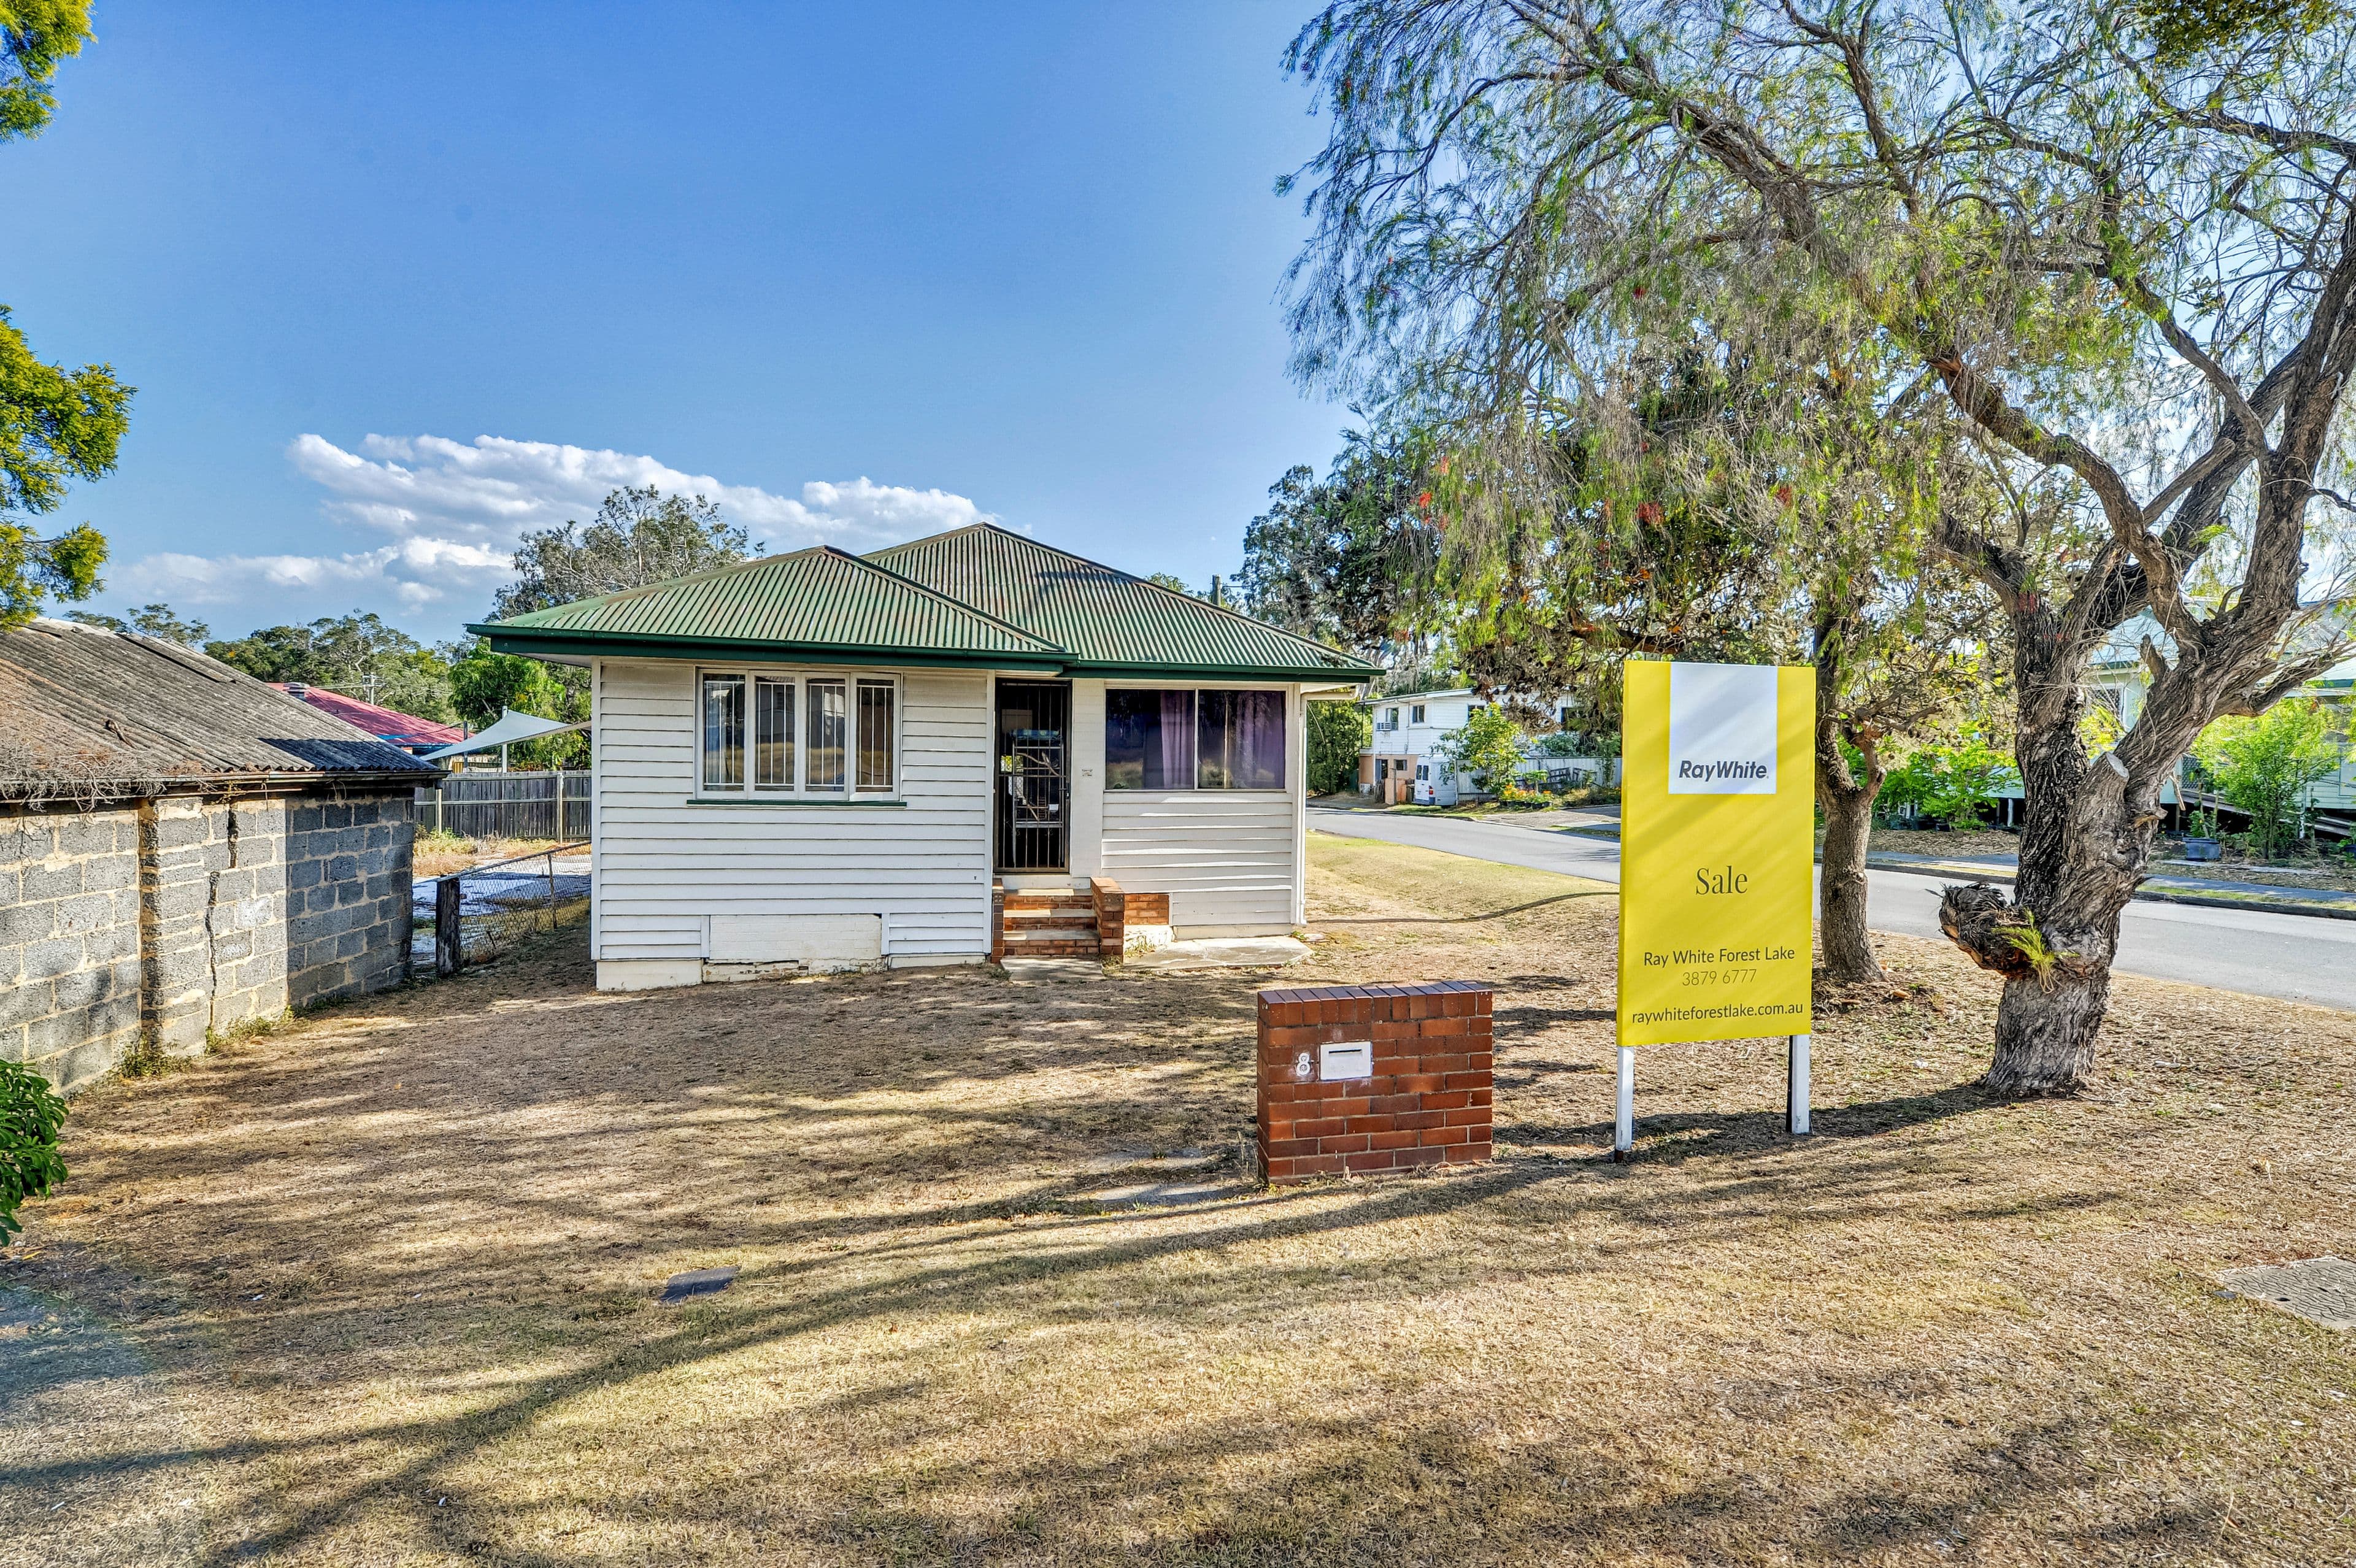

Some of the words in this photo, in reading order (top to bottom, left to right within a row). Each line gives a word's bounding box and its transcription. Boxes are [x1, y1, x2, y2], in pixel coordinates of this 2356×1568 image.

[1696, 865, 1748, 895] Sale
[1644, 951, 1669, 968] Ray
[1673, 949, 1715, 964] White
[1719, 948, 1761, 963] Forest
[1765, 945, 1795, 961] Lake
[1682, 970, 1717, 986] 3879
[1722, 968, 1757, 984] 6777
[1632, 1002, 1804, 1025] raywhiteforestlake.com.au
[1295, 1052, 1311, 1076] 8
